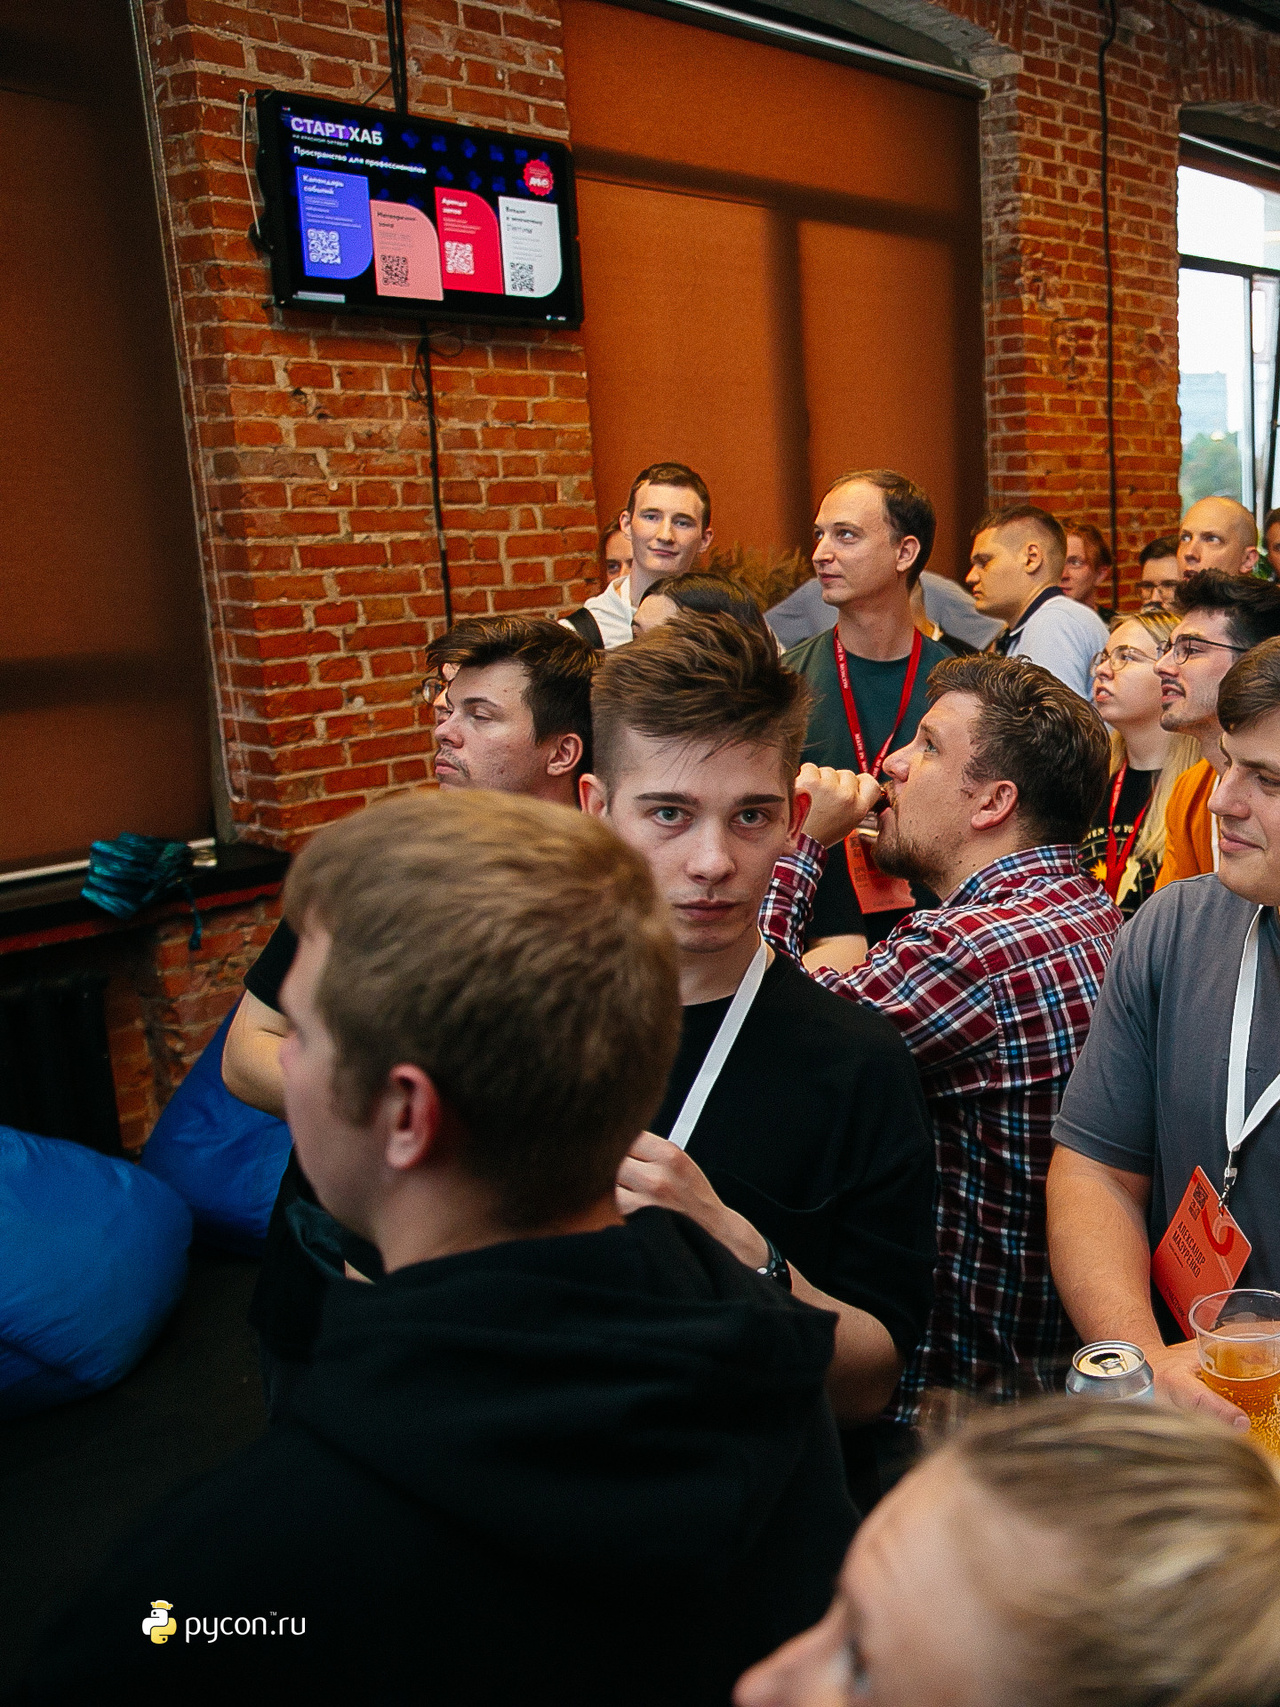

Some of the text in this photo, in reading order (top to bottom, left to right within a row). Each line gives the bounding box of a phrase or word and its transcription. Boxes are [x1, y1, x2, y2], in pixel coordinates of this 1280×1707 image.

[291, 117, 383, 146] СТАРТ ХАБ
[293, 145, 427, 174] Пространство для профессионалов
[1172, 1230, 1201, 1278] МАЗУРЕНКО
[1176, 1221, 1206, 1266] АЛЕКСАНДР
